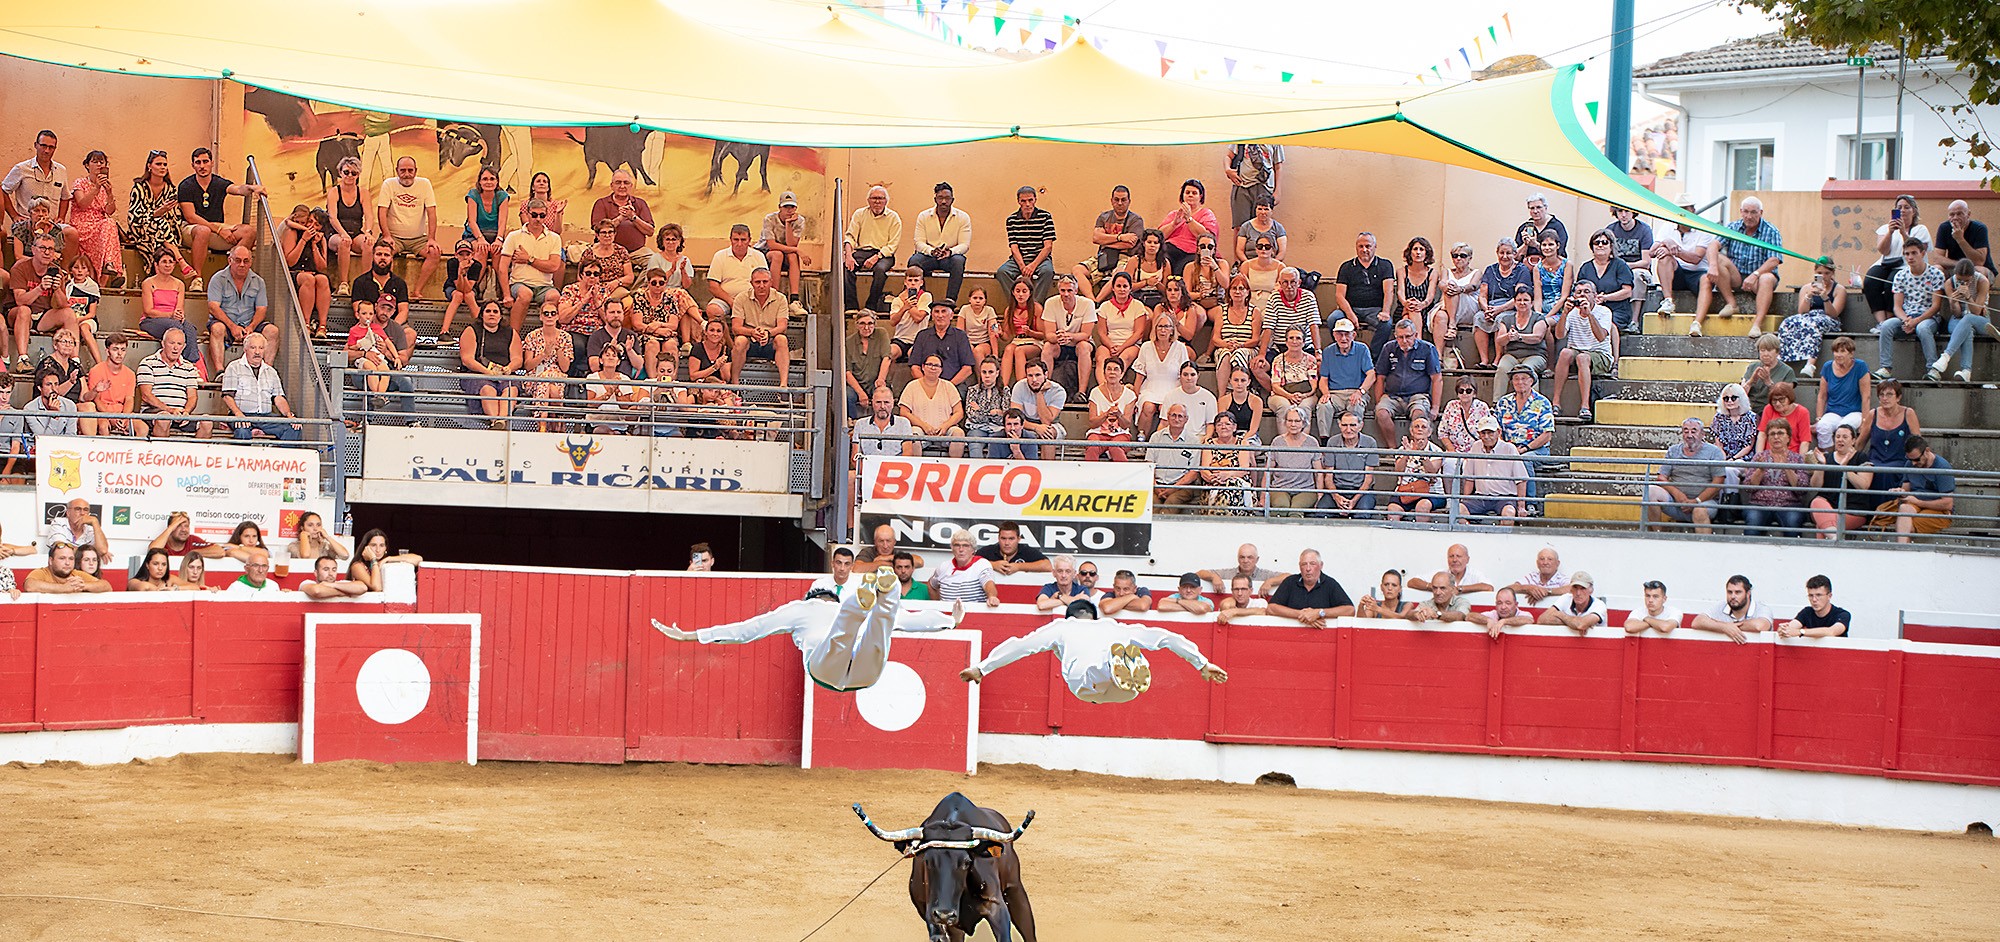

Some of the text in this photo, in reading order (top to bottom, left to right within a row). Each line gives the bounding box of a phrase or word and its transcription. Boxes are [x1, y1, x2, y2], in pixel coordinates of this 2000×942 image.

[88, 449, 307, 473] COMITÉ RÉGIONAL DE L'ARMAGNAC
[412, 455, 532, 468] CLUBS
[621, 464, 743, 477] TAURINS
[104, 472, 163, 487] CASINO
[176, 474, 211, 488] RADIO
[248, 481, 282, 490] DÉPARTEMENT
[412, 466, 742, 491] PAUL RICARD
[871, 461, 1042, 505] BRICO
[104, 487, 146, 495] BARBOTAN
[1040, 493, 1138, 513] MARCHÉ
[195, 509, 265, 522] maison coco-picoty
